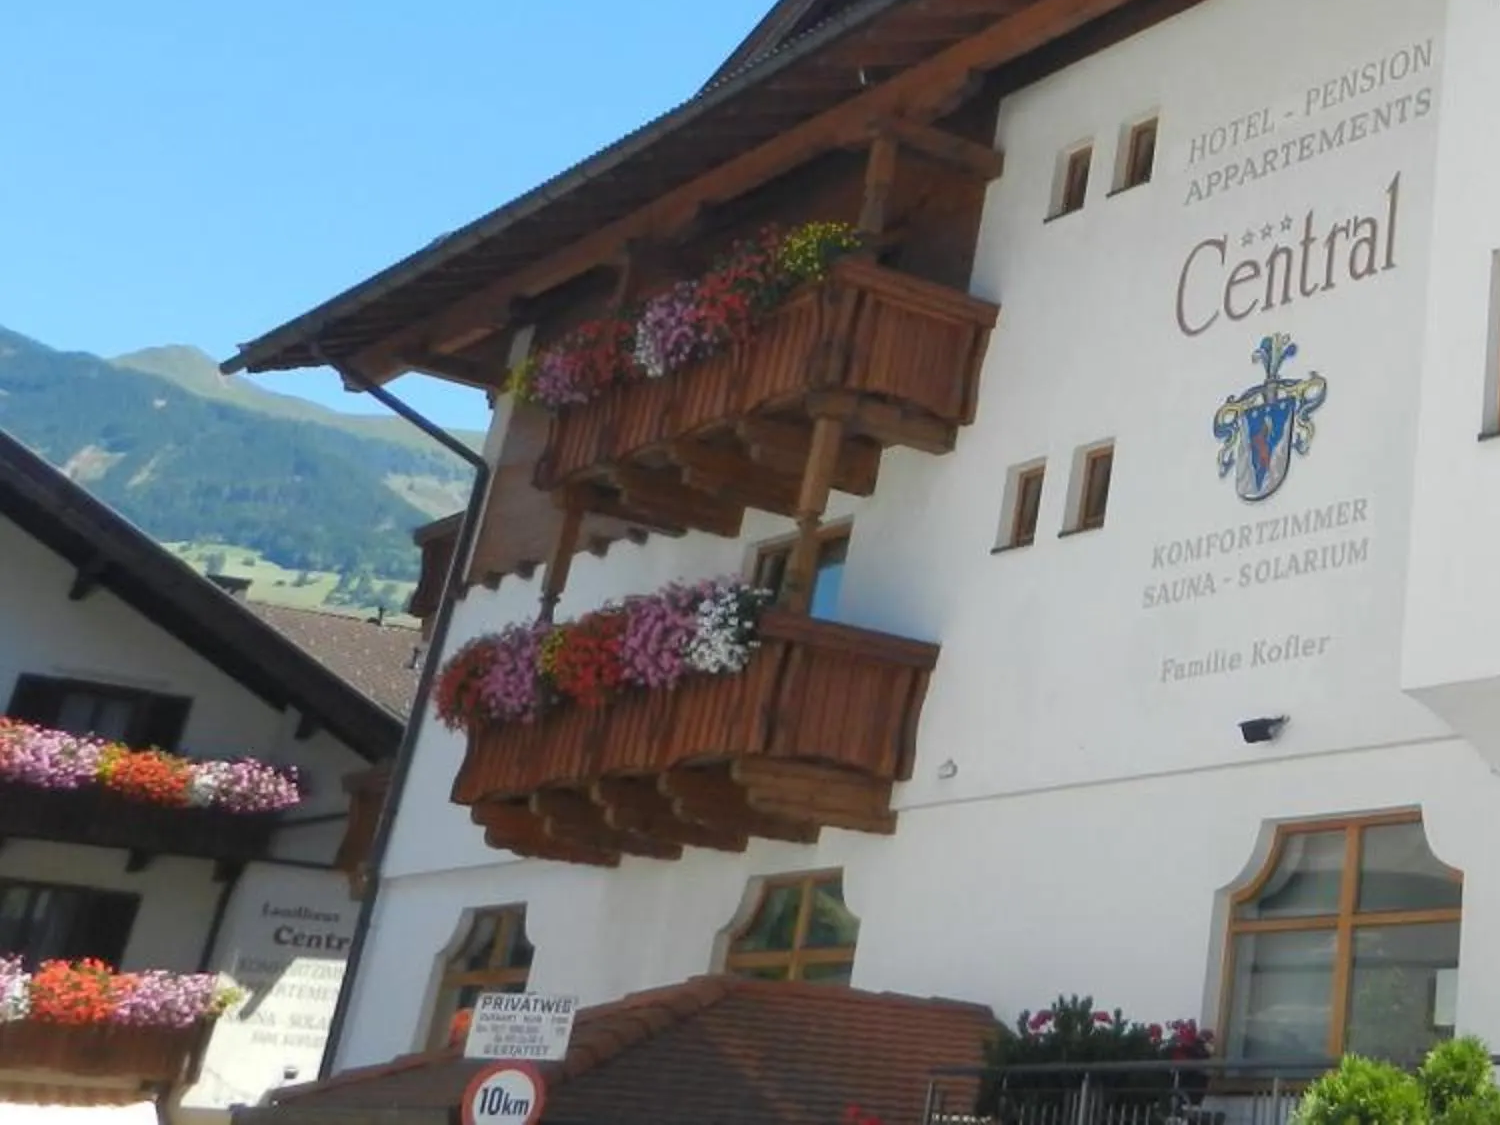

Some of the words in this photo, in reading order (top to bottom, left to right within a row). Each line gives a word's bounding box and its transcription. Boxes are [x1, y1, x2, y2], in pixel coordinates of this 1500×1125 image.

[1183, 88, 1433, 206] APPARTEMENTS
[1188, 107, 1275, 165] HOTEL
[1304, 39, 1434, 116] PENSION
[1176, 170, 1401, 337] Central
[1142, 572, 1217, 609] SAUNA
[1238, 538, 1370, 589] SOLARIUM
[1151, 498, 1369, 569] KOMFORTZIMMER
[1160, 648, 1243, 683] Familie
[1250, 635, 1332, 668] Kofler
